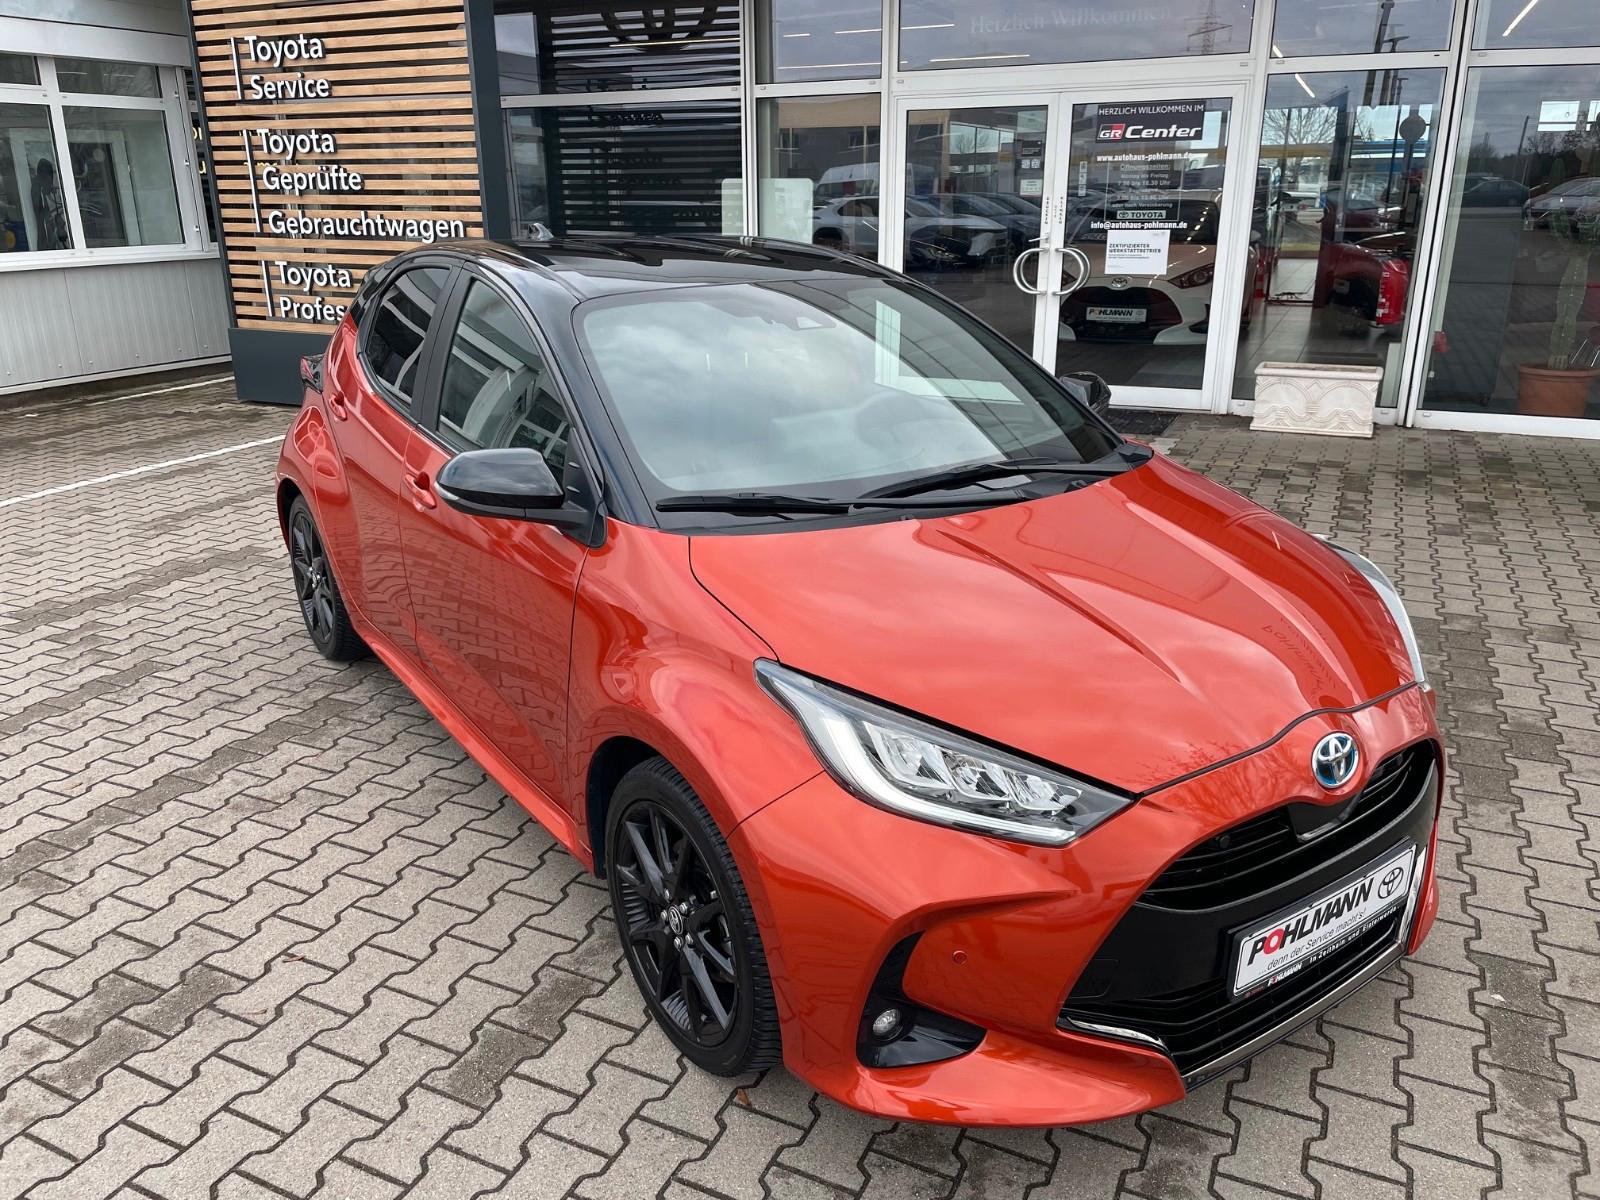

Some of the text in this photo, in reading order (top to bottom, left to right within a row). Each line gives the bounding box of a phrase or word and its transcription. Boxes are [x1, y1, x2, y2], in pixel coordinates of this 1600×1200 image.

[970, 14, 1045, 33] Herzlich
[244, 34, 324, 67] Toyota
[250, 72, 330, 100] Service
[1098, 104, 1204, 116] HERZLICH WILLKOMMEN IM
[257, 128, 336, 161] Toyota
[1099, 124, 1202, 139] GR Center
[1097, 151, 1193, 162] www.autohaus-pohlmann.de
[262, 165, 363, 196] Geprüfte
[268, 210, 465, 243] Gebrauchtwagen
[1091, 221, 1187, 230] info@autohaus-pohlmann.de
[275, 261, 351, 292] Toyota
[1247, 877, 1374, 966] POHLMANN
[1290, 943, 1305, 961] der
[1304, 929, 1335, 951] Service
